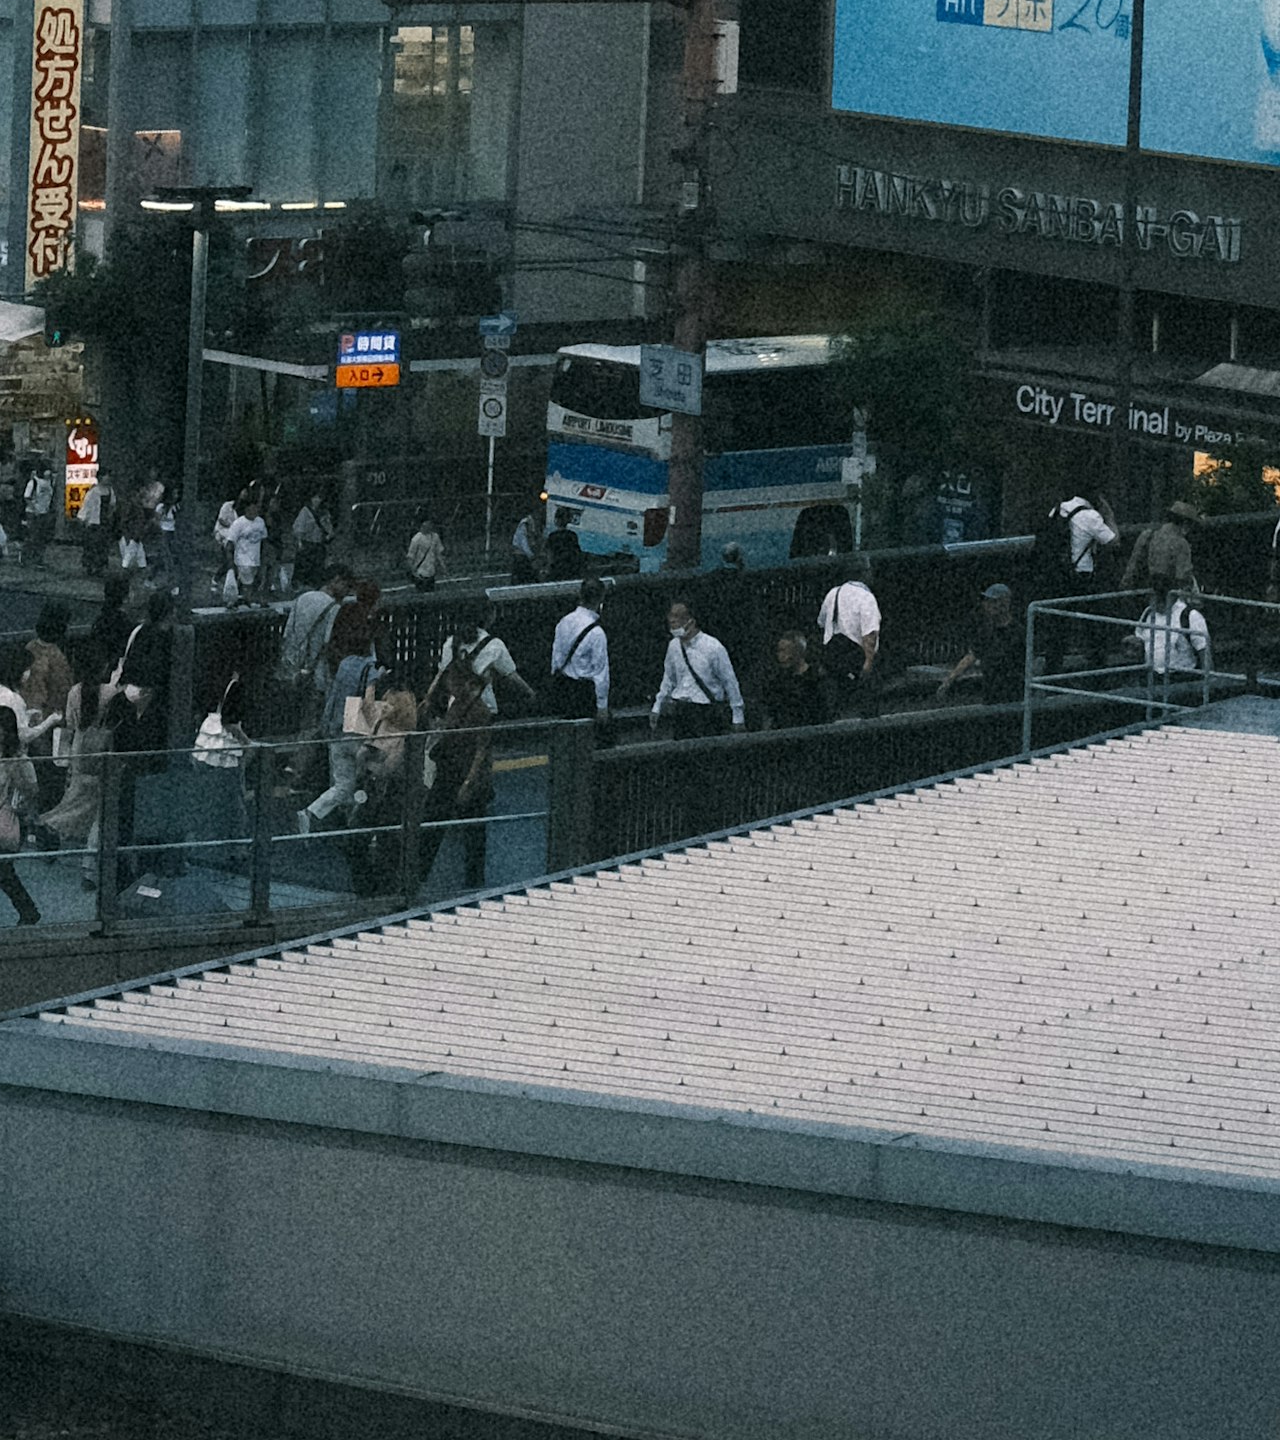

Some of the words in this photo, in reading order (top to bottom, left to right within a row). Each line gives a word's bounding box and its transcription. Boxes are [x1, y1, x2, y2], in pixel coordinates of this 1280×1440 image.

[30, 6, 82, 280] 処方せん受付
[1015, 384, 1065, 425] City
[1174, 422, 1192, 443] by
